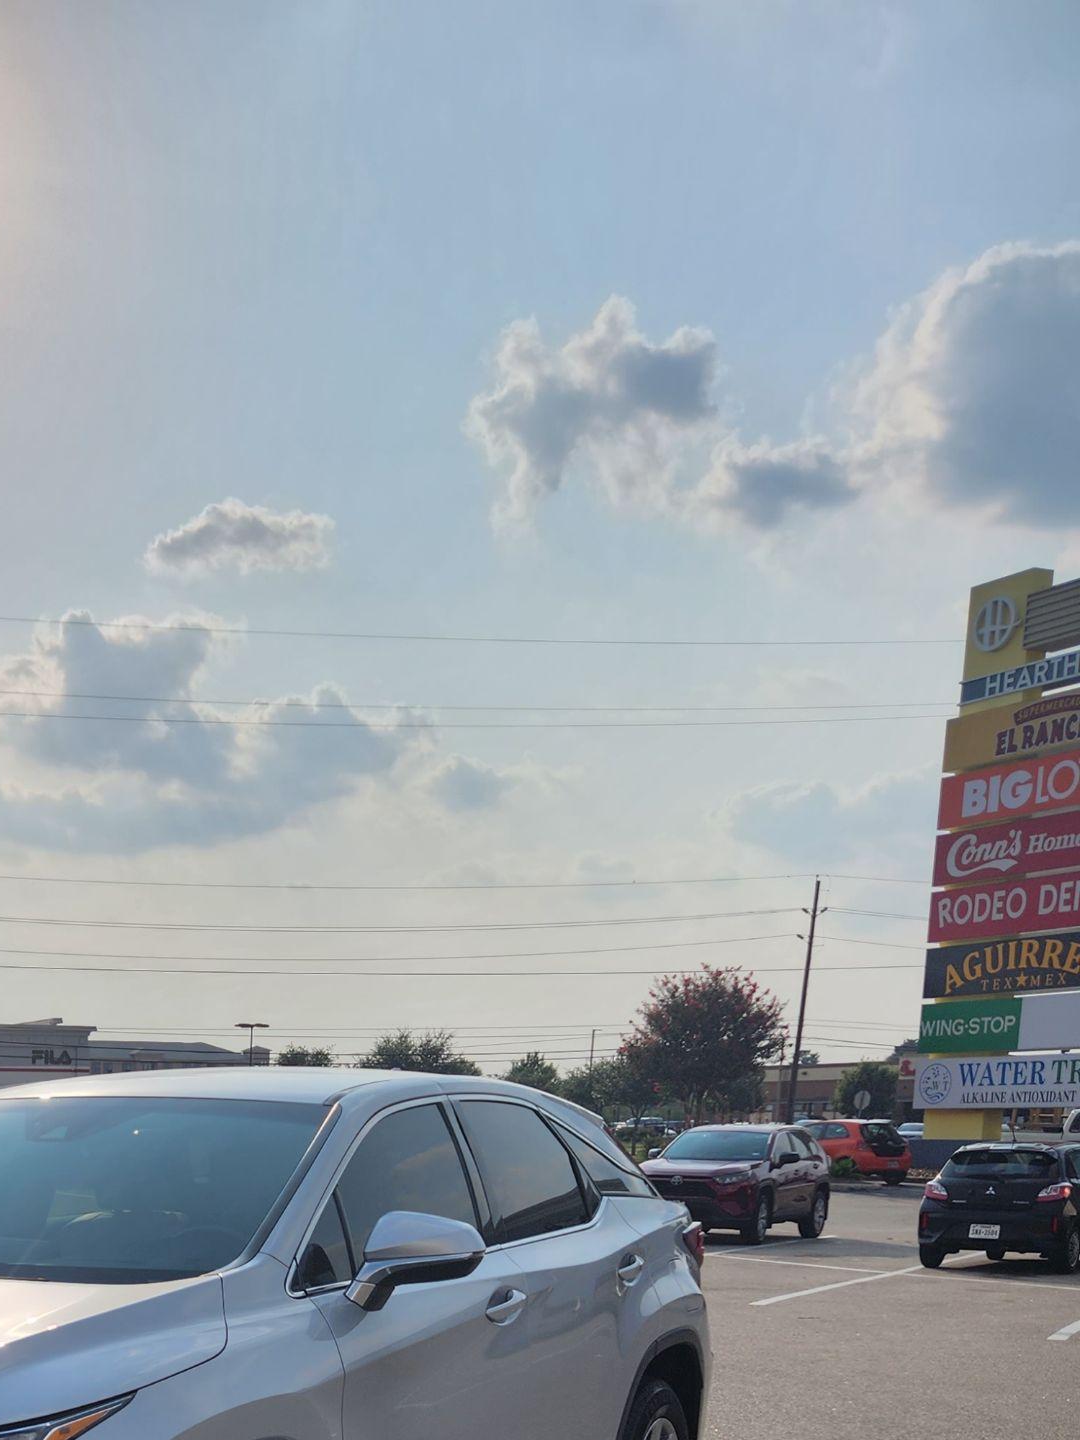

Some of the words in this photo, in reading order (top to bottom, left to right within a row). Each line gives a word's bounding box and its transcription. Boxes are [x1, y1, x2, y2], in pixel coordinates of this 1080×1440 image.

[984, 653, 1080, 698] HEARTH
[994, 728, 1018, 756] EL
[1021, 713, 1080, 749] RANC
[961, 770, 1034, 818] BIG
[1035, 760, 1080, 804] LO
[946, 829, 1022, 877] Conn's
[937, 887, 1027, 928] RODEO
[944, 938, 1080, 994] AGUIRRE
[980, 977, 1012, 991] TEX
[1030, 972, 1067, 987] MEX
[31, 1049, 72, 1065] FILA
[958, 1060, 1046, 1087] WATER
[960, 1091, 1007, 1104] ALKALINE
[1010, 1089, 1077, 1103] ANTIOXIDANT
